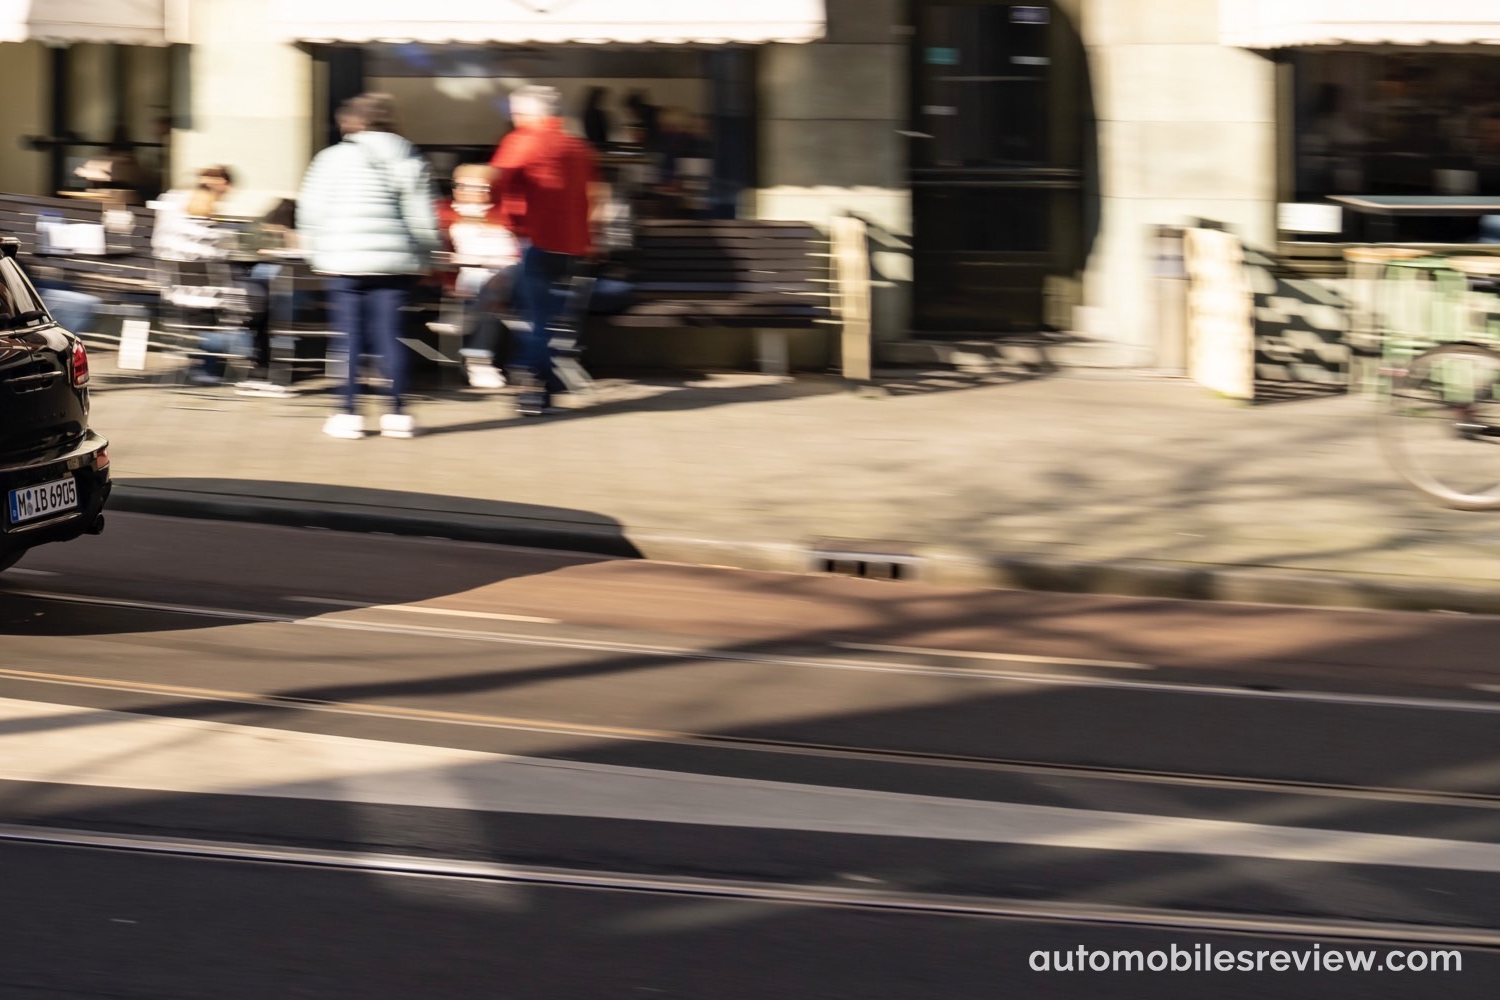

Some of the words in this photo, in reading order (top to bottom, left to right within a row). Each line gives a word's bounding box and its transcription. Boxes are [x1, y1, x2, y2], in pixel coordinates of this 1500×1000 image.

[18, 493, 27, 517] M
[34, 488, 48, 512] IB
[50, 481, 75, 508] 6905
